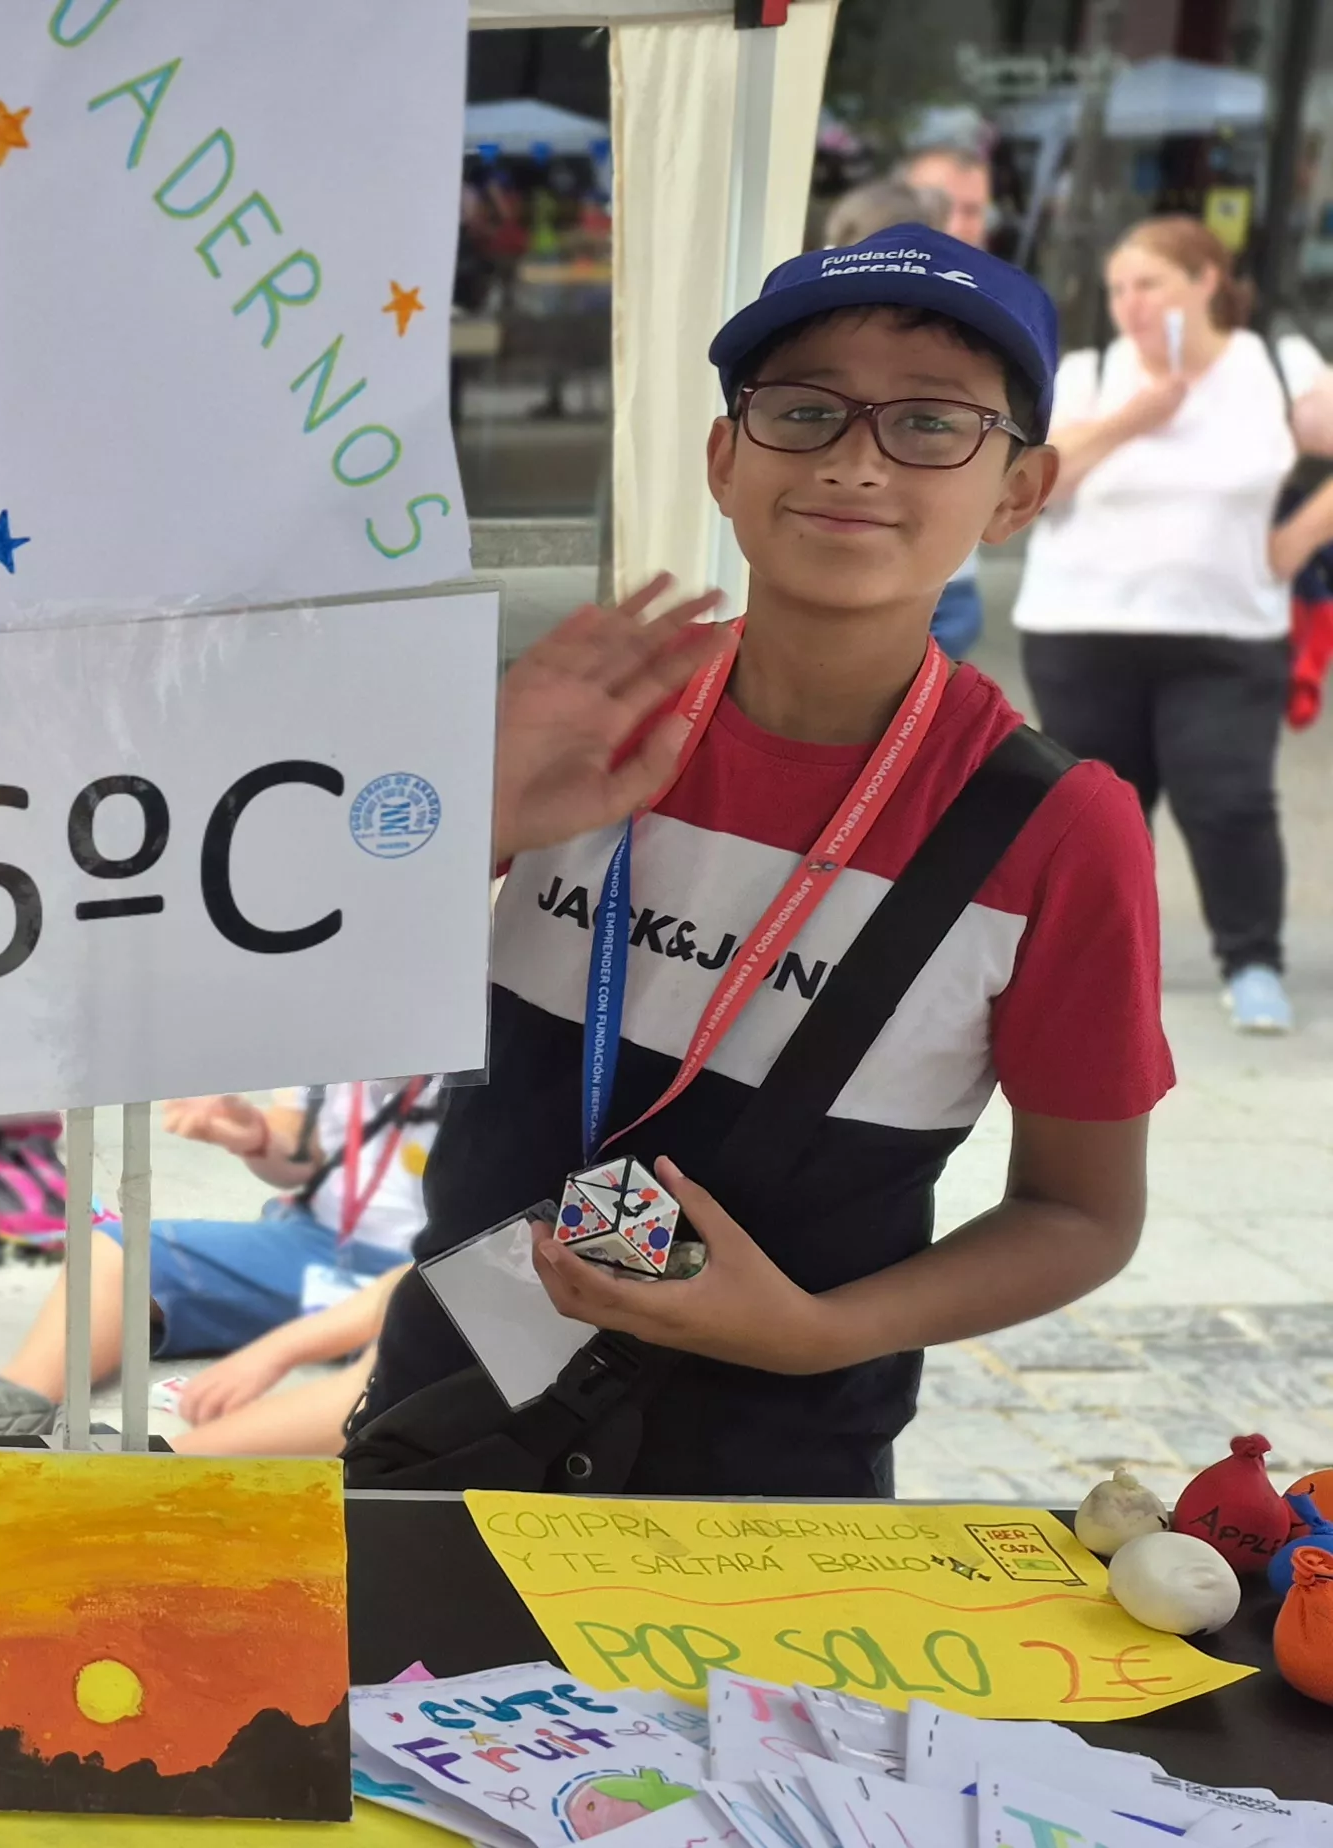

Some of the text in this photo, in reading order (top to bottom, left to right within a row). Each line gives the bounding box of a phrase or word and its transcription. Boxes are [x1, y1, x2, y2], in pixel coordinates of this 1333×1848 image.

[821, 248, 931, 269] Fundación
[898, 715, 917, 740] CON
[861, 739, 905, 803] FUNDACIÓN
[825, 802, 867, 855] IBERCAJA
[755, 876, 814, 952] APRENDIENDO
[600, 911, 616, 984] EMPRENDER
[596, 986, 609, 1012] CON
[706, 964, 753, 1031] EMPRENDER
[592, 1014, 609, 1080] FUNDACIÓN
[487, 1511, 670, 1541] COMPRA
[999, 1543, 1044, 1554] CAJA
[503, 1549, 536, 1572] Y
[550, 1551, 619, 1575] TE
[632, 1544, 784, 1576] SALTARÁ
[575, 1620, 1210, 1704] POR SOLO 2€
[418, 1684, 618, 1730] CUTE
